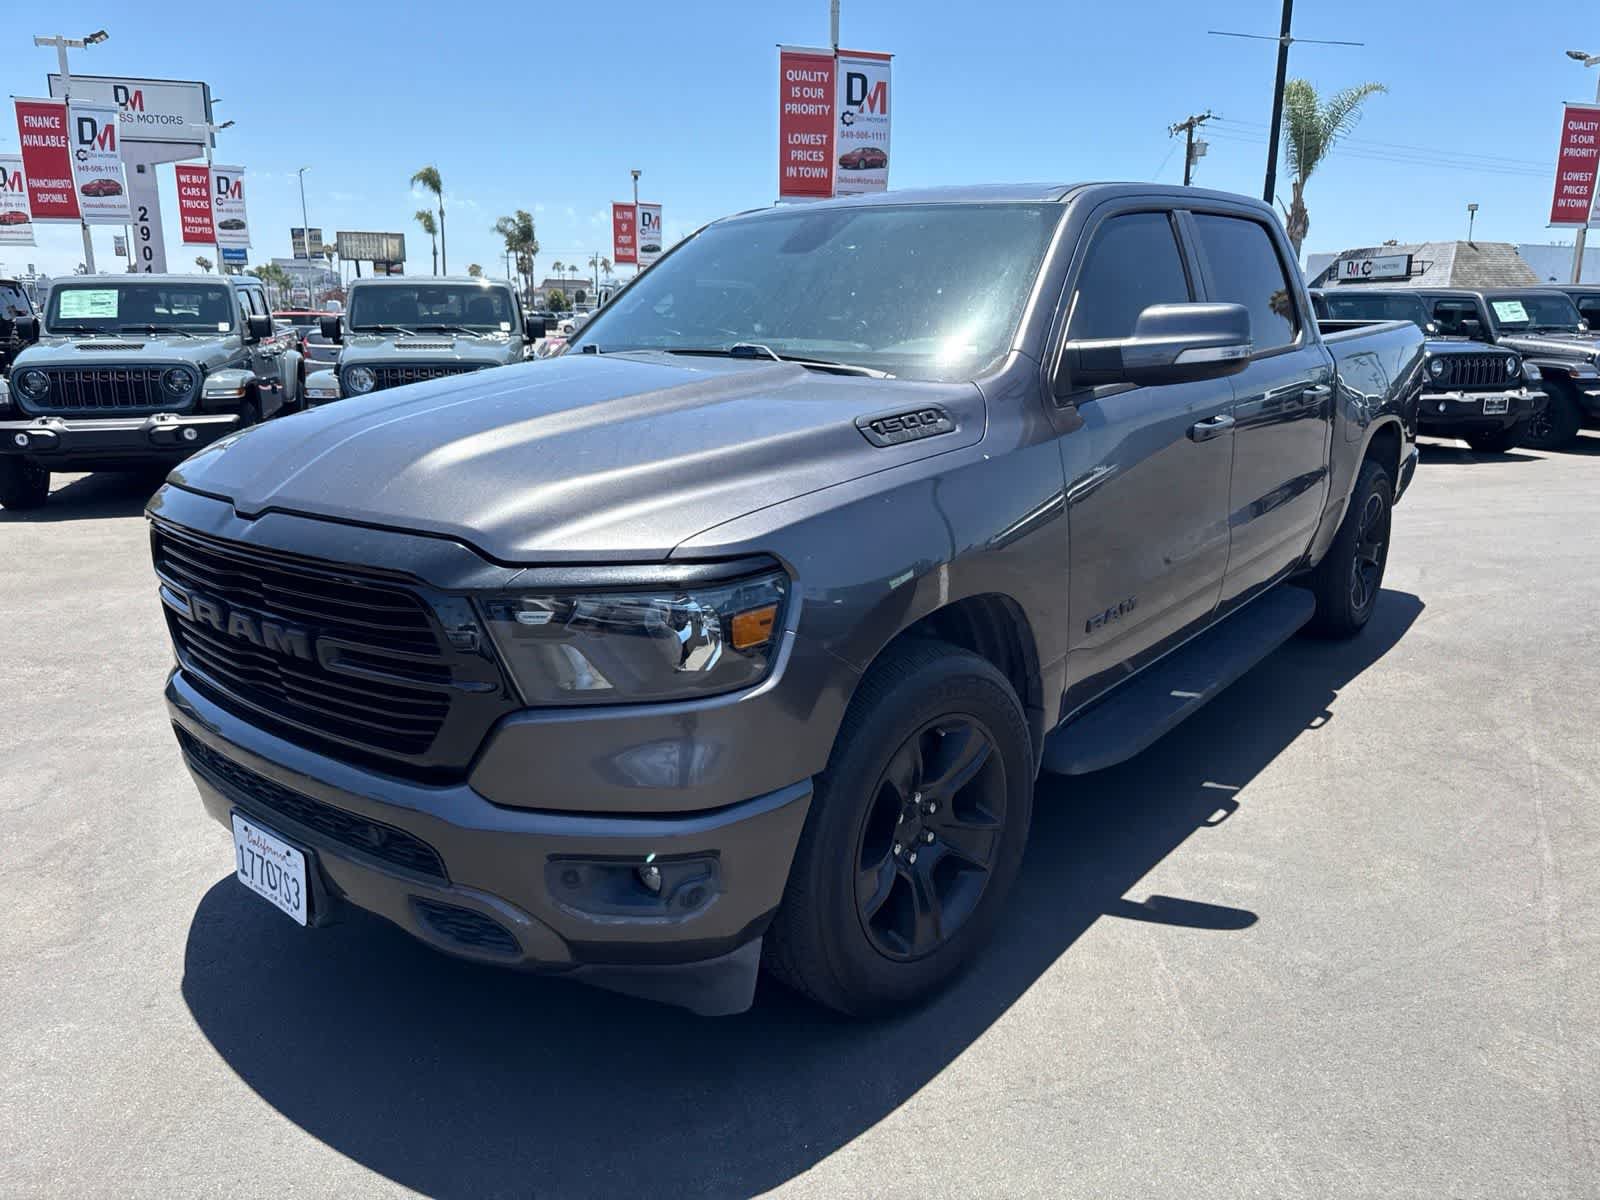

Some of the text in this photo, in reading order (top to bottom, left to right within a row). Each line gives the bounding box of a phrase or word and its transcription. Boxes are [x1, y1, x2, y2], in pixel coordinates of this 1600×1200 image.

[786, 70, 829, 82] QUALITY
[113, 85, 144, 111] DM
[792, 87, 824, 98] IS OUR
[846, 72, 887, 115] DM
[785, 104, 830, 115] PRIORITY
[23, 115, 61, 129] FINANCE
[137, 114, 184, 125] MOTORS
[1567, 121, 1598, 131] QUALITY
[77, 117, 116, 152] DM
[788, 133, 827, 145] LOWEST
[1570, 135, 1594, 144] IS OUR
[23, 134, 66, 147] AVAILABLE
[791, 151, 824, 162] PRICES
[1563, 148, 1598, 157] PRIORITY
[786, 167, 828, 178] IN TOWN
[1562, 172, 1592, 181] LOWEST
[179, 175, 206, 184] WE BUY
[182, 188, 207, 196] CARS &
[216, 175, 242, 200] DM
[1562, 186, 1588, 195] PRICES
[182, 200, 209, 209] TRUCKS
[1557, 199, 1588, 208] IN TOWN
[642, 212, 660, 231] DM
[184, 226, 212, 234] ACCEPTED
[871, 410, 938, 435] 1500
[1085, 596, 1137, 632] RAM
[191, 591, 314, 661] RAM
[247, 828, 287, 862] California
